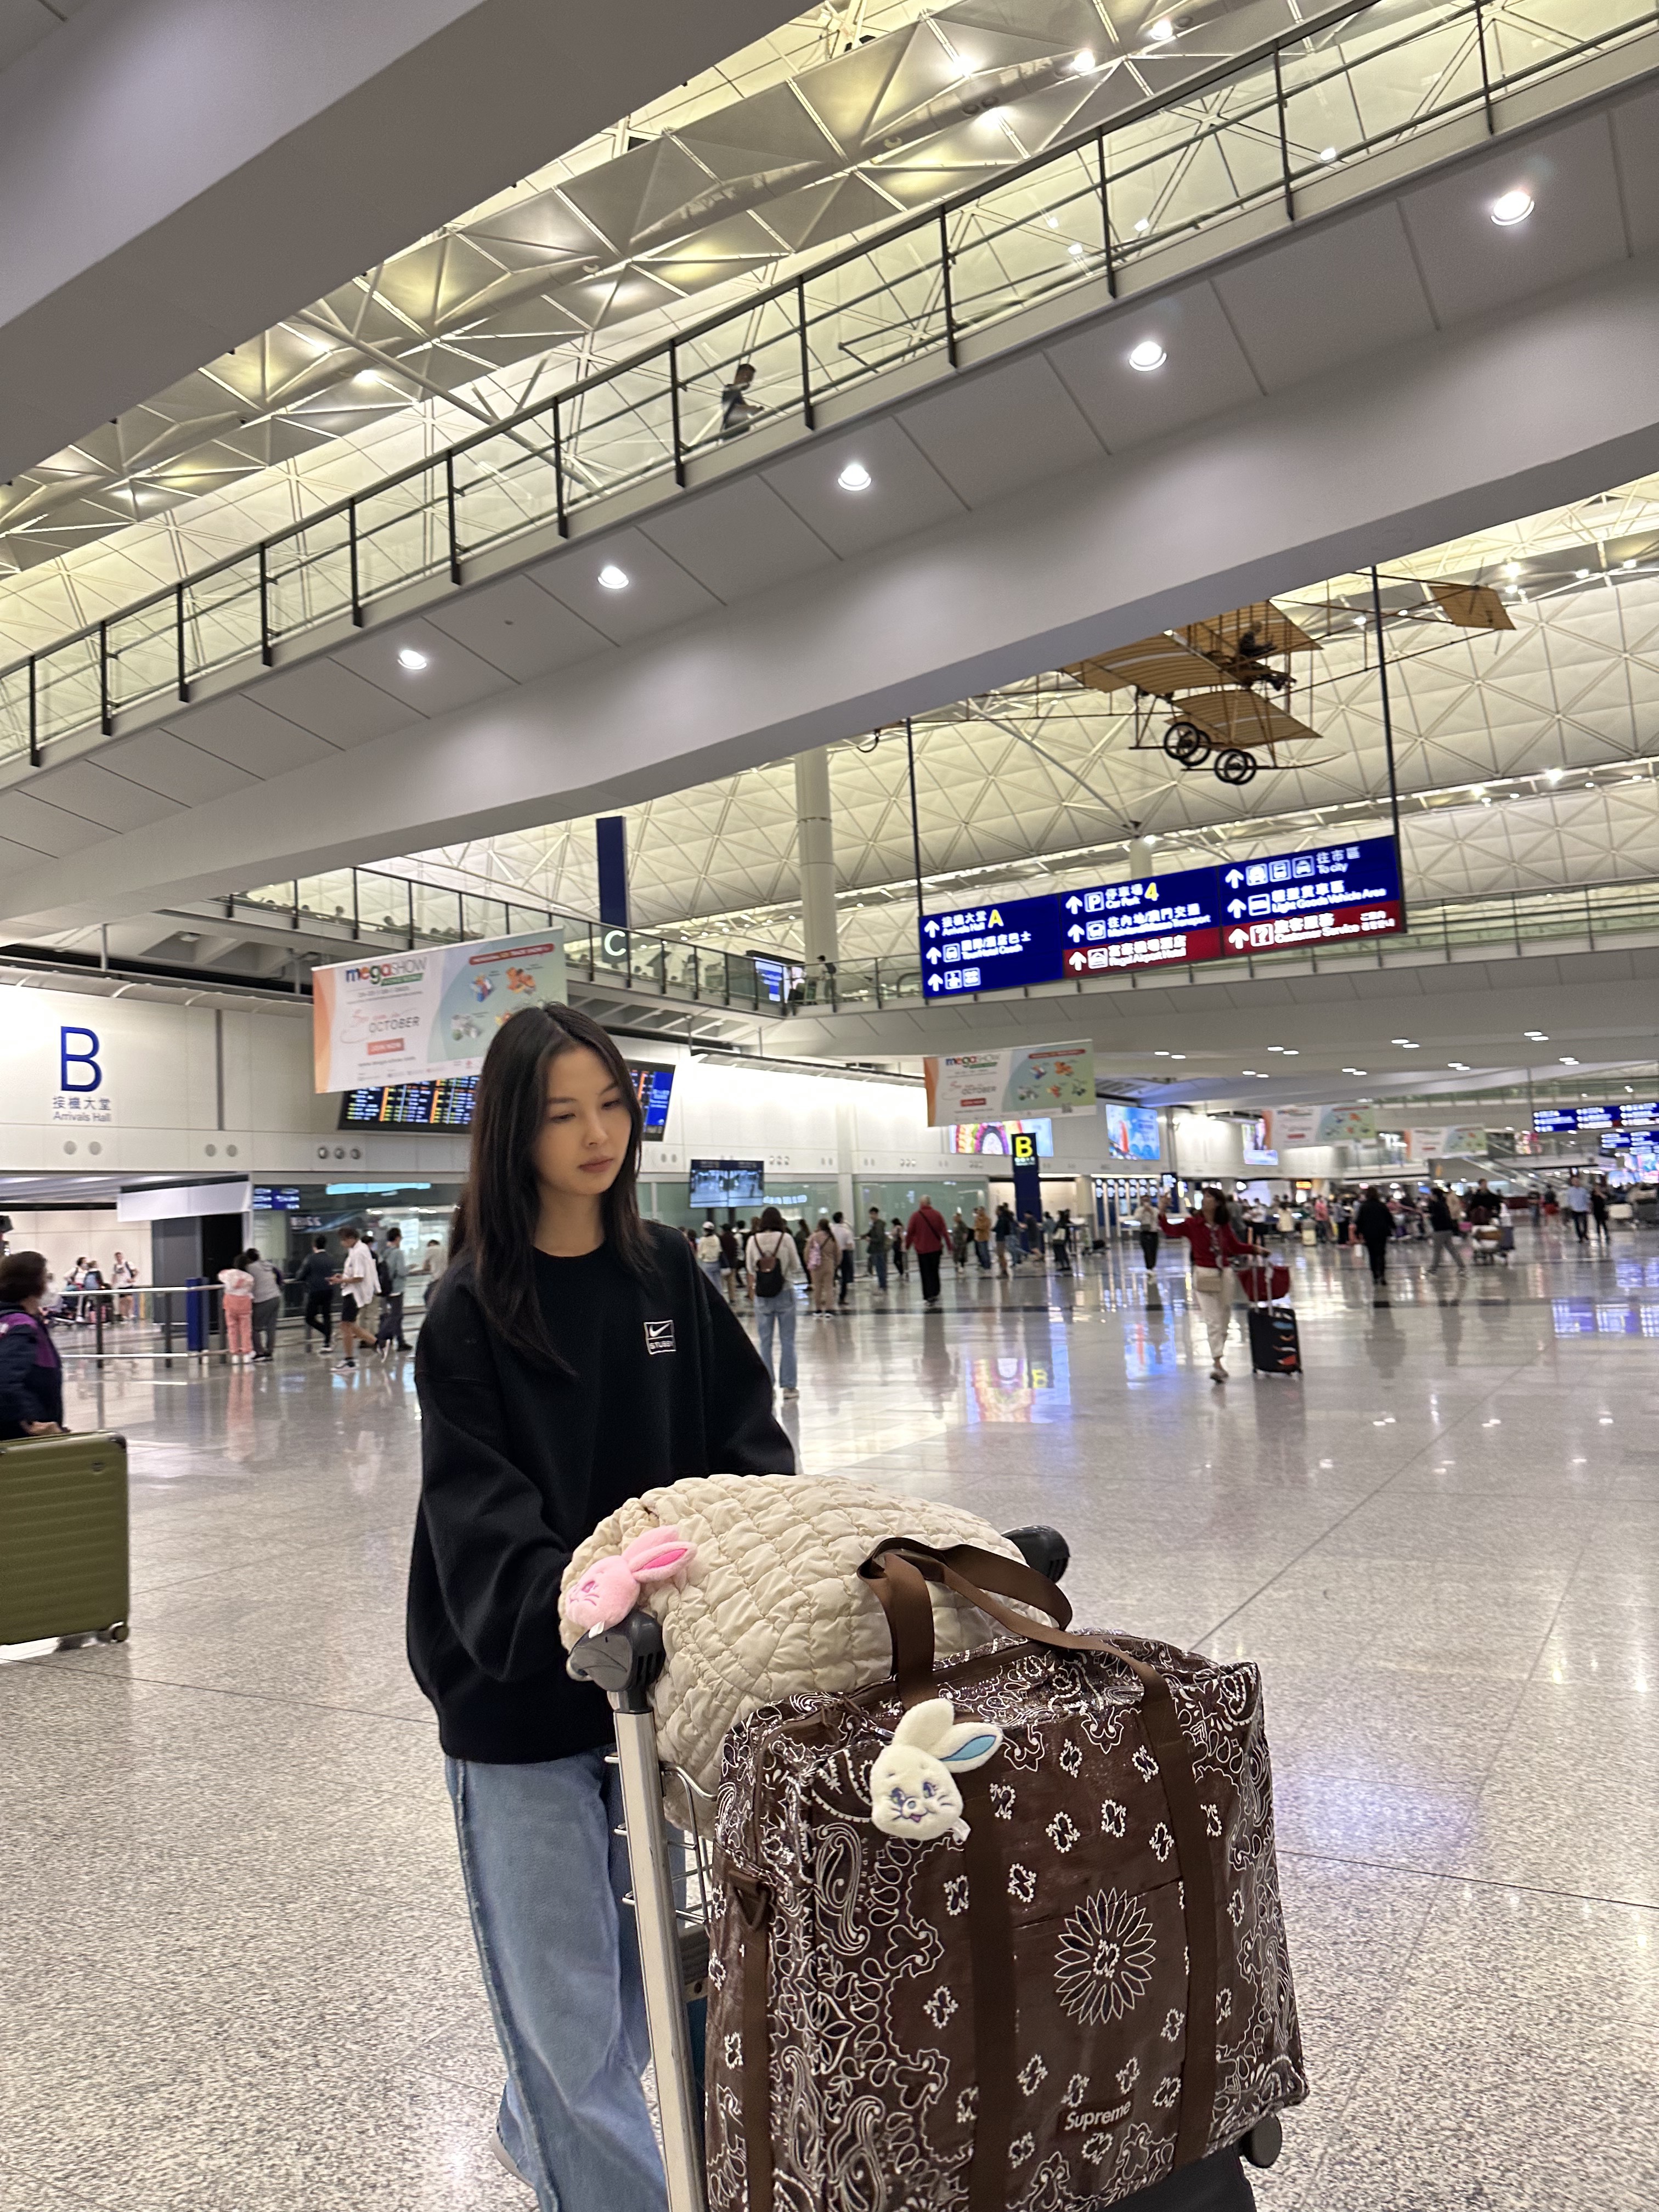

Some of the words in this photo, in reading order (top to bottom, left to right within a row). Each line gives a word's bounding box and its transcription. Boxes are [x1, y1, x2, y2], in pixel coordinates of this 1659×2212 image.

[1317, 865, 1330, 874] To
[1330, 862, 1348, 873] city
[1144, 882, 1159, 901] 4
[1272, 900, 1297, 913] Light
[1296, 896, 1329, 909] Goods
[1327, 890, 1362, 904] Vehicle
[1362, 888, 1387, 899] Area
[1105, 900, 1121, 909] Car
[1121, 896, 1141, 906] Park
[988, 909, 1004, 928] A
[604, 930, 627, 956] C
[1274, 929, 1322, 944] Customer
[1322, 923, 1360, 937] Service
[1133, 950, 1163, 963] Airport
[1162, 947, 1187, 958] Hotel
[369, 1016, 420, 1033] OCTOBER
[60, 1026, 103, 1092] B
[53, 1096, 111, 1111] 接機大堂
[53, 1111, 91, 1122] Arrivals
[92, 1112, 111, 1122] Hall
[1015, 1136, 1033, 1158] B
[1064, 2101, 1131, 2132] Supreme
